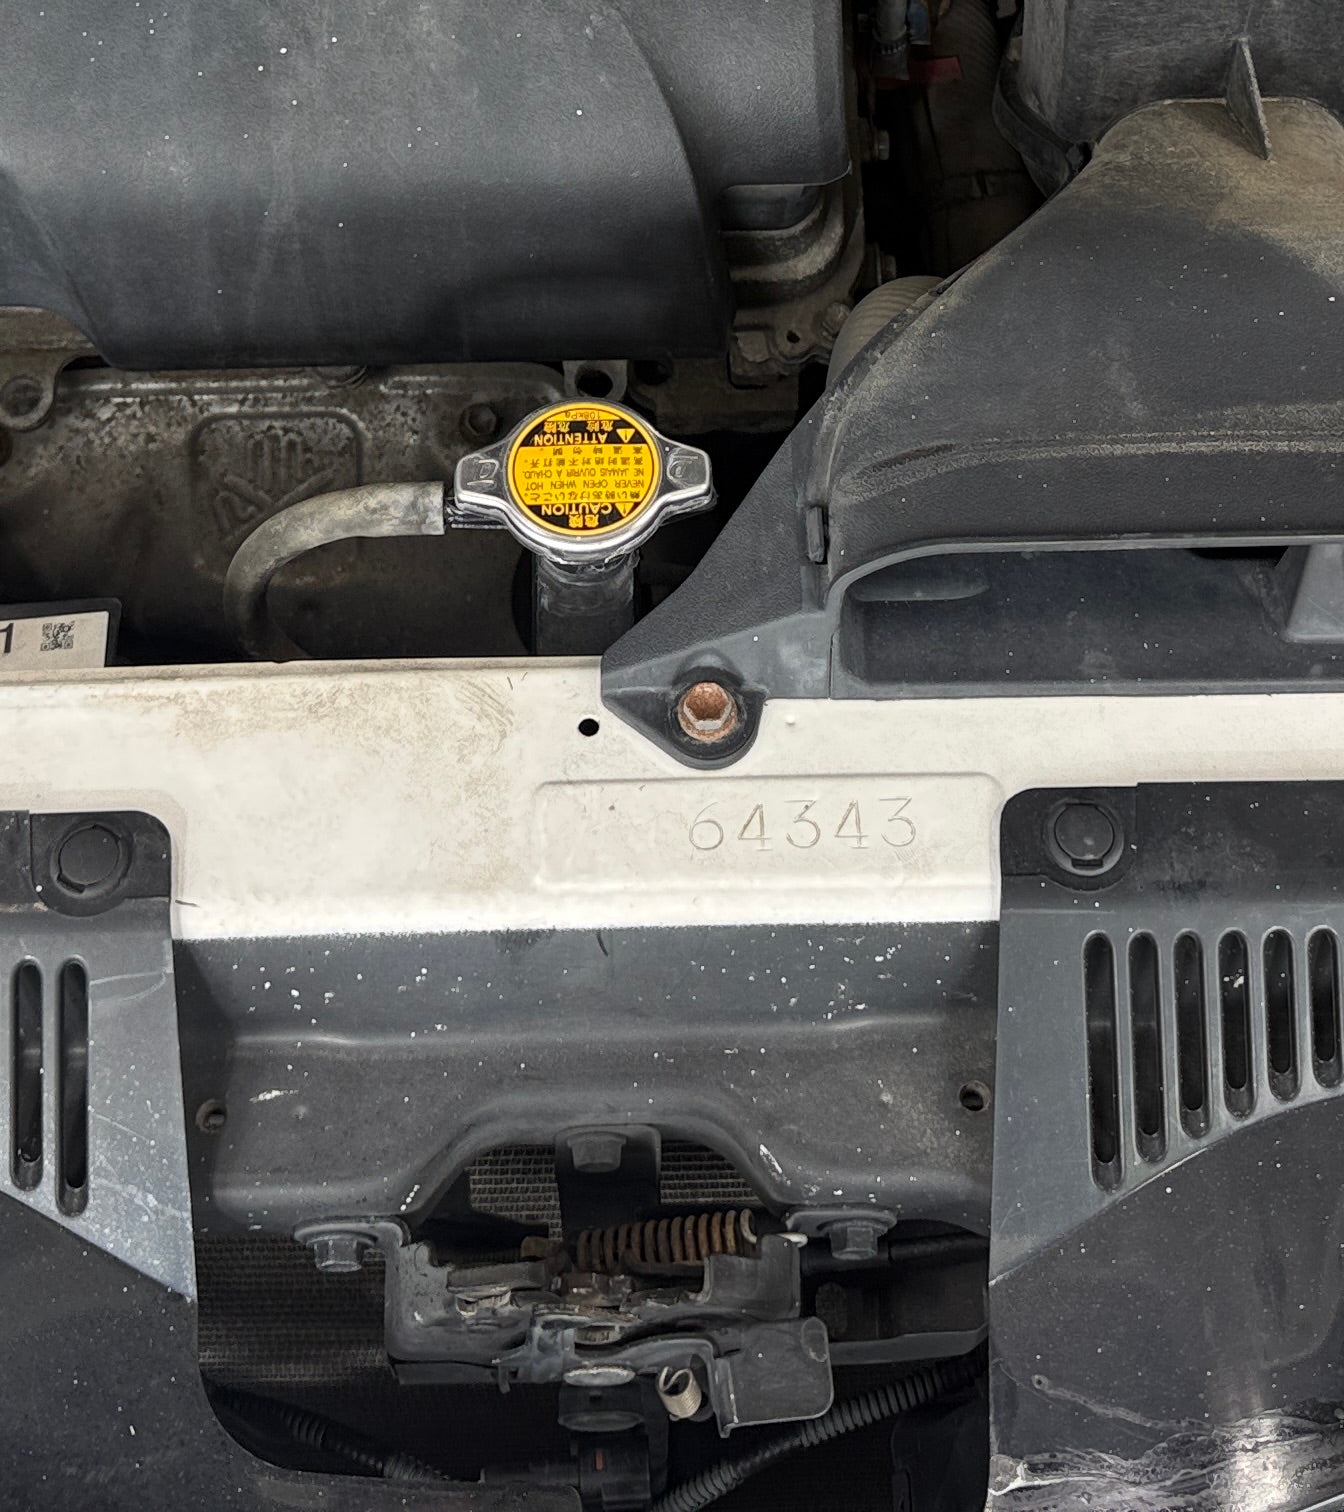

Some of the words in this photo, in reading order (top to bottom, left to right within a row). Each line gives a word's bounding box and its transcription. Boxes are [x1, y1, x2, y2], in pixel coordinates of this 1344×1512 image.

[534, 432, 608, 445] ATTENTION
[565, 468, 596, 477] OUVRIR
[599, 467, 629, 476] JAMAIS
[633, 468, 643, 476] NE
[525, 481, 543, 490] HOT
[550, 480, 576, 489] WHEN
[583, 479, 607, 488] OPEN
[614, 479, 643, 488] NEVER
[541, 503, 612, 515] CAUTION
[688, 795, 917, 852] 64343
